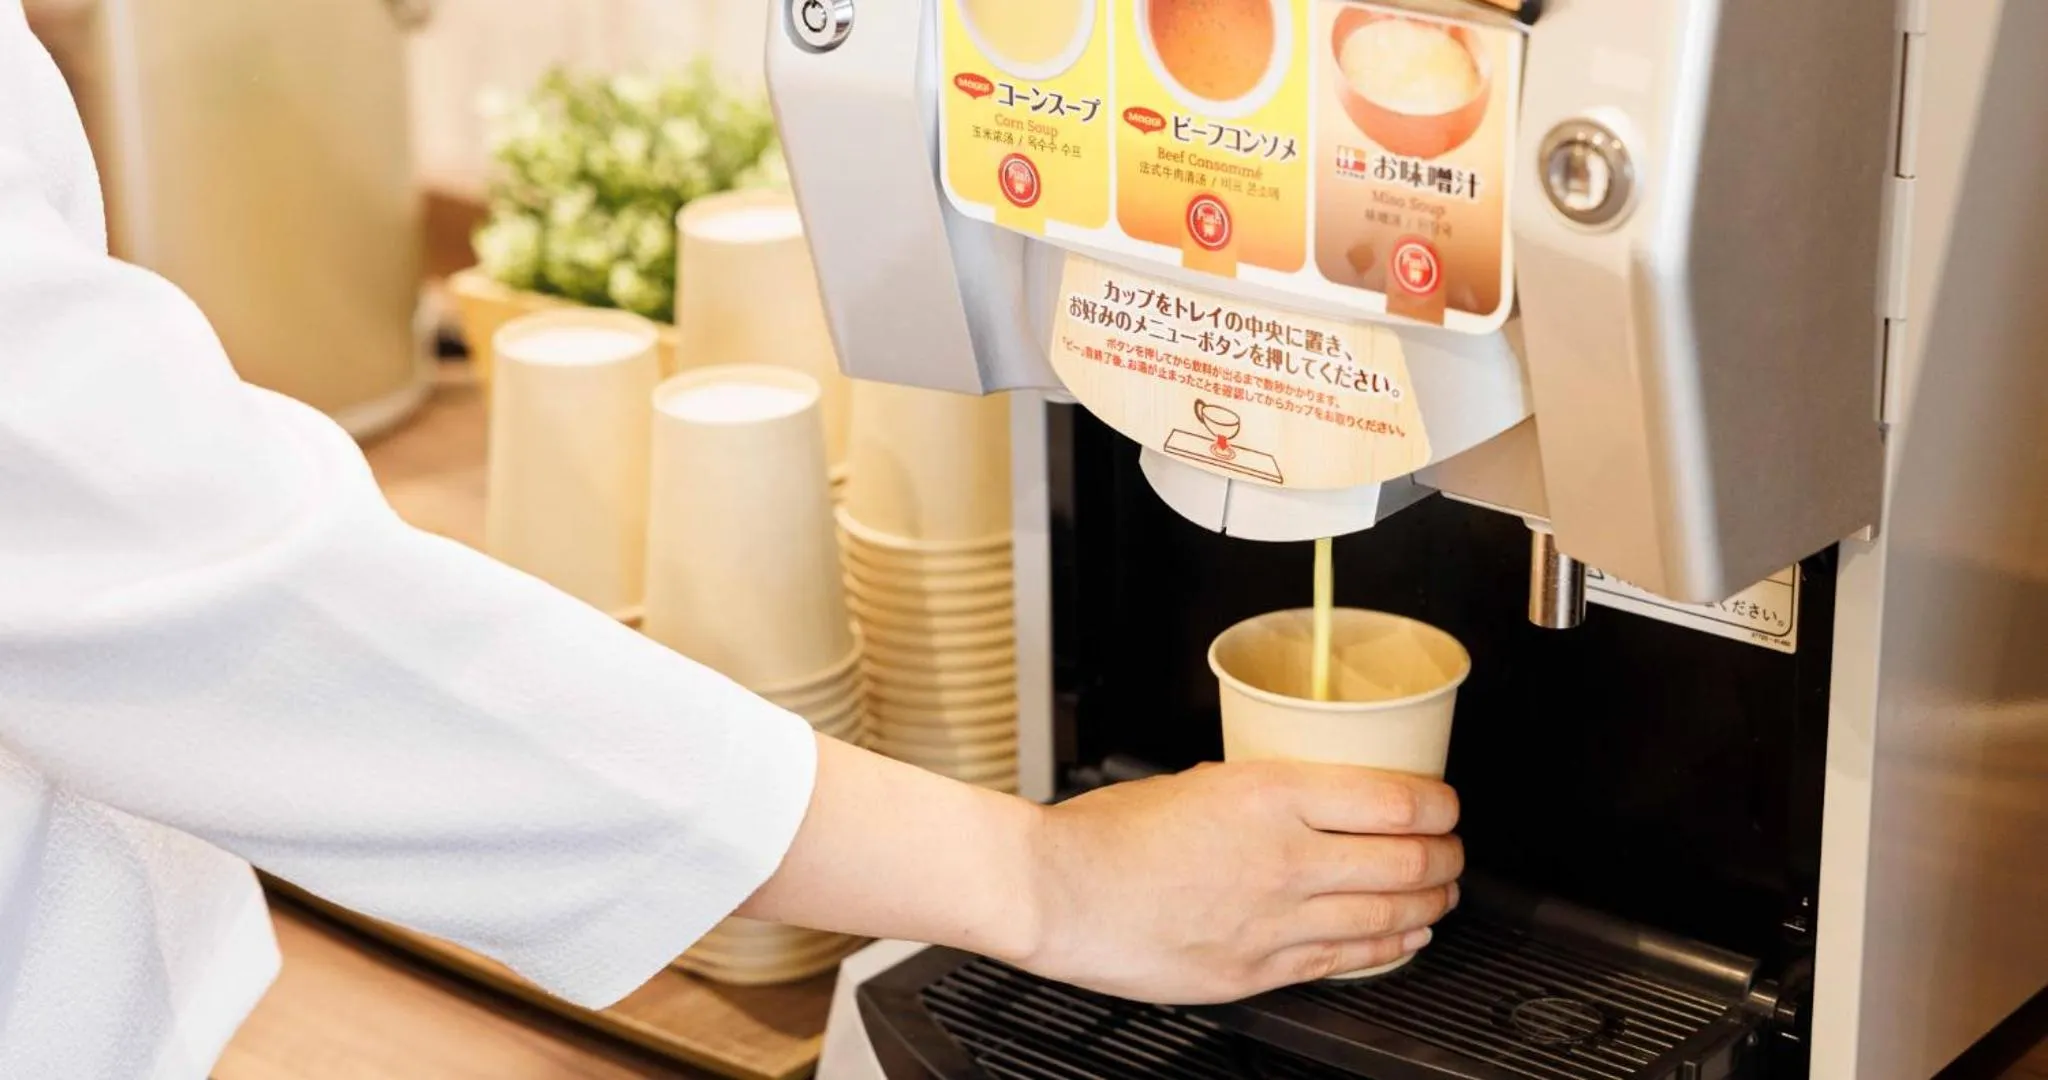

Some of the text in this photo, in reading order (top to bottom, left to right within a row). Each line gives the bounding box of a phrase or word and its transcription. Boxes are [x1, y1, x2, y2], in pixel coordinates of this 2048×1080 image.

[997, 82, 1102, 122] コーンスープ
[994, 113, 1058, 138] Corn Soup
[1027, 135, 1058, 153] 옥수수
[1174, 116, 1297, 161] ビーフコンソメ
[1157, 146, 1263, 180] Beef Consommé
[1374, 156, 1480, 199] お味噌汁
[1372, 188, 1447, 219] Miso Soup
[1104, 280, 1353, 361] カップをトレイの中央に置き、
[1069, 296, 1400, 398] お好みのメニューボタンを押してください。
